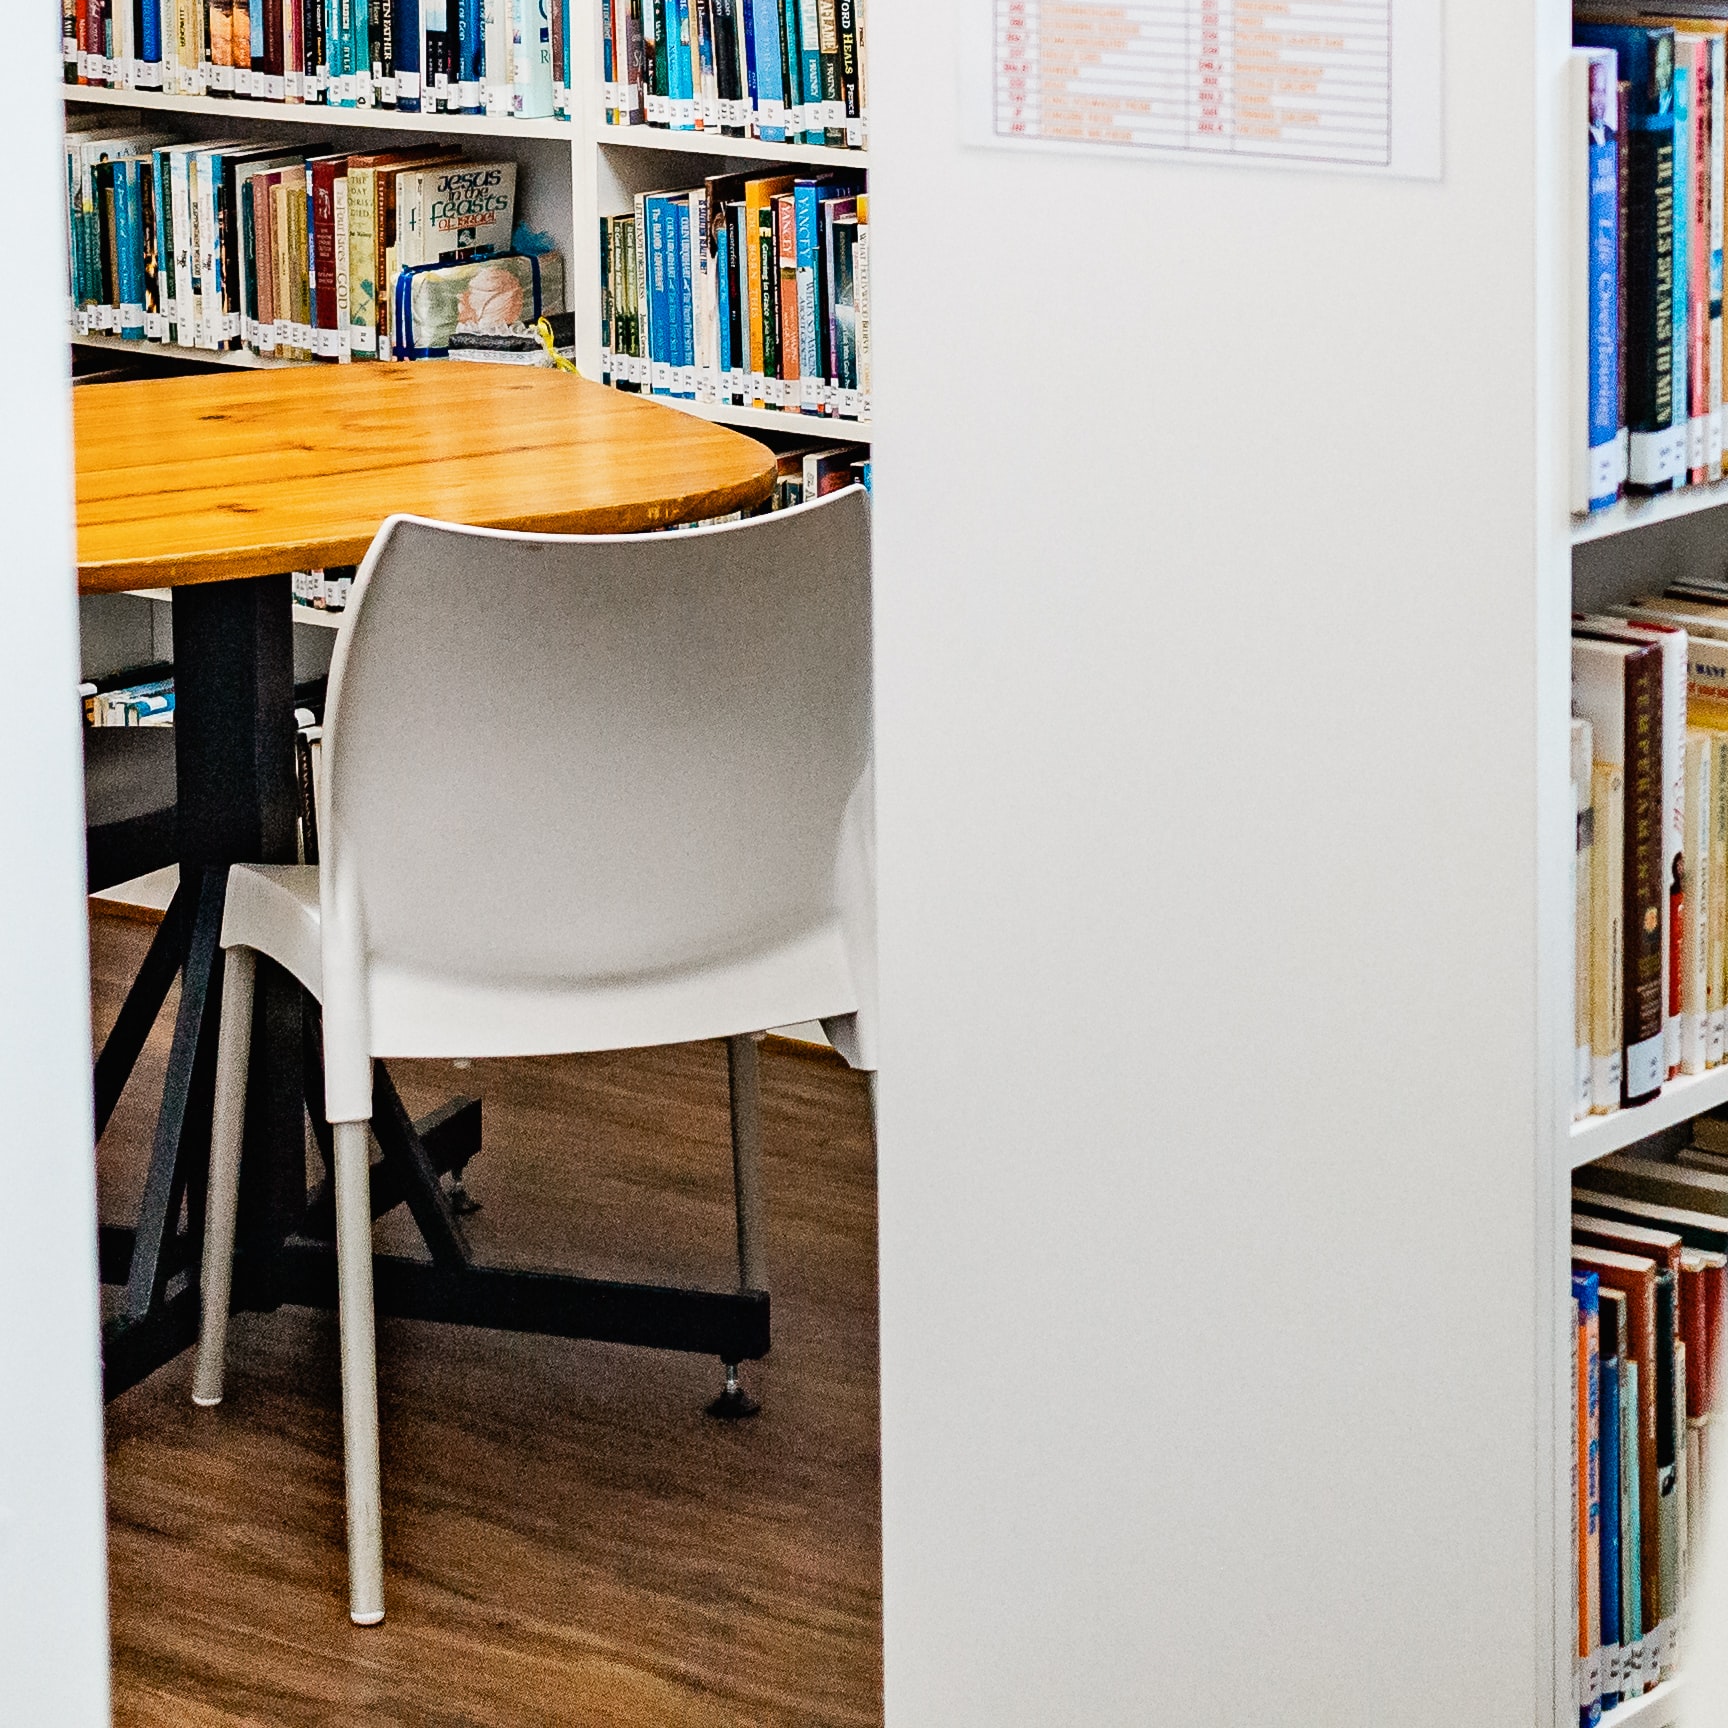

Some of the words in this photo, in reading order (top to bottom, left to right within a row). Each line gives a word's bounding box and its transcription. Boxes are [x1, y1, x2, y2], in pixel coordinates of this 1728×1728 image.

[383, 20, 392, 60] FATHER
[821, 3, 834, 49] AFLAME
[842, 34, 853, 74] HEALS
[847, 84, 855, 115] PRINCE
[781, 205, 793, 256] YANCEY
[798, 196, 811, 257] YANCEY
[859, 233, 867, 260] WHAT
[338, 273, 348, 309] GOD
[763, 282, 769, 290] in
[860, 264, 868, 317] HOLLYWOOD
